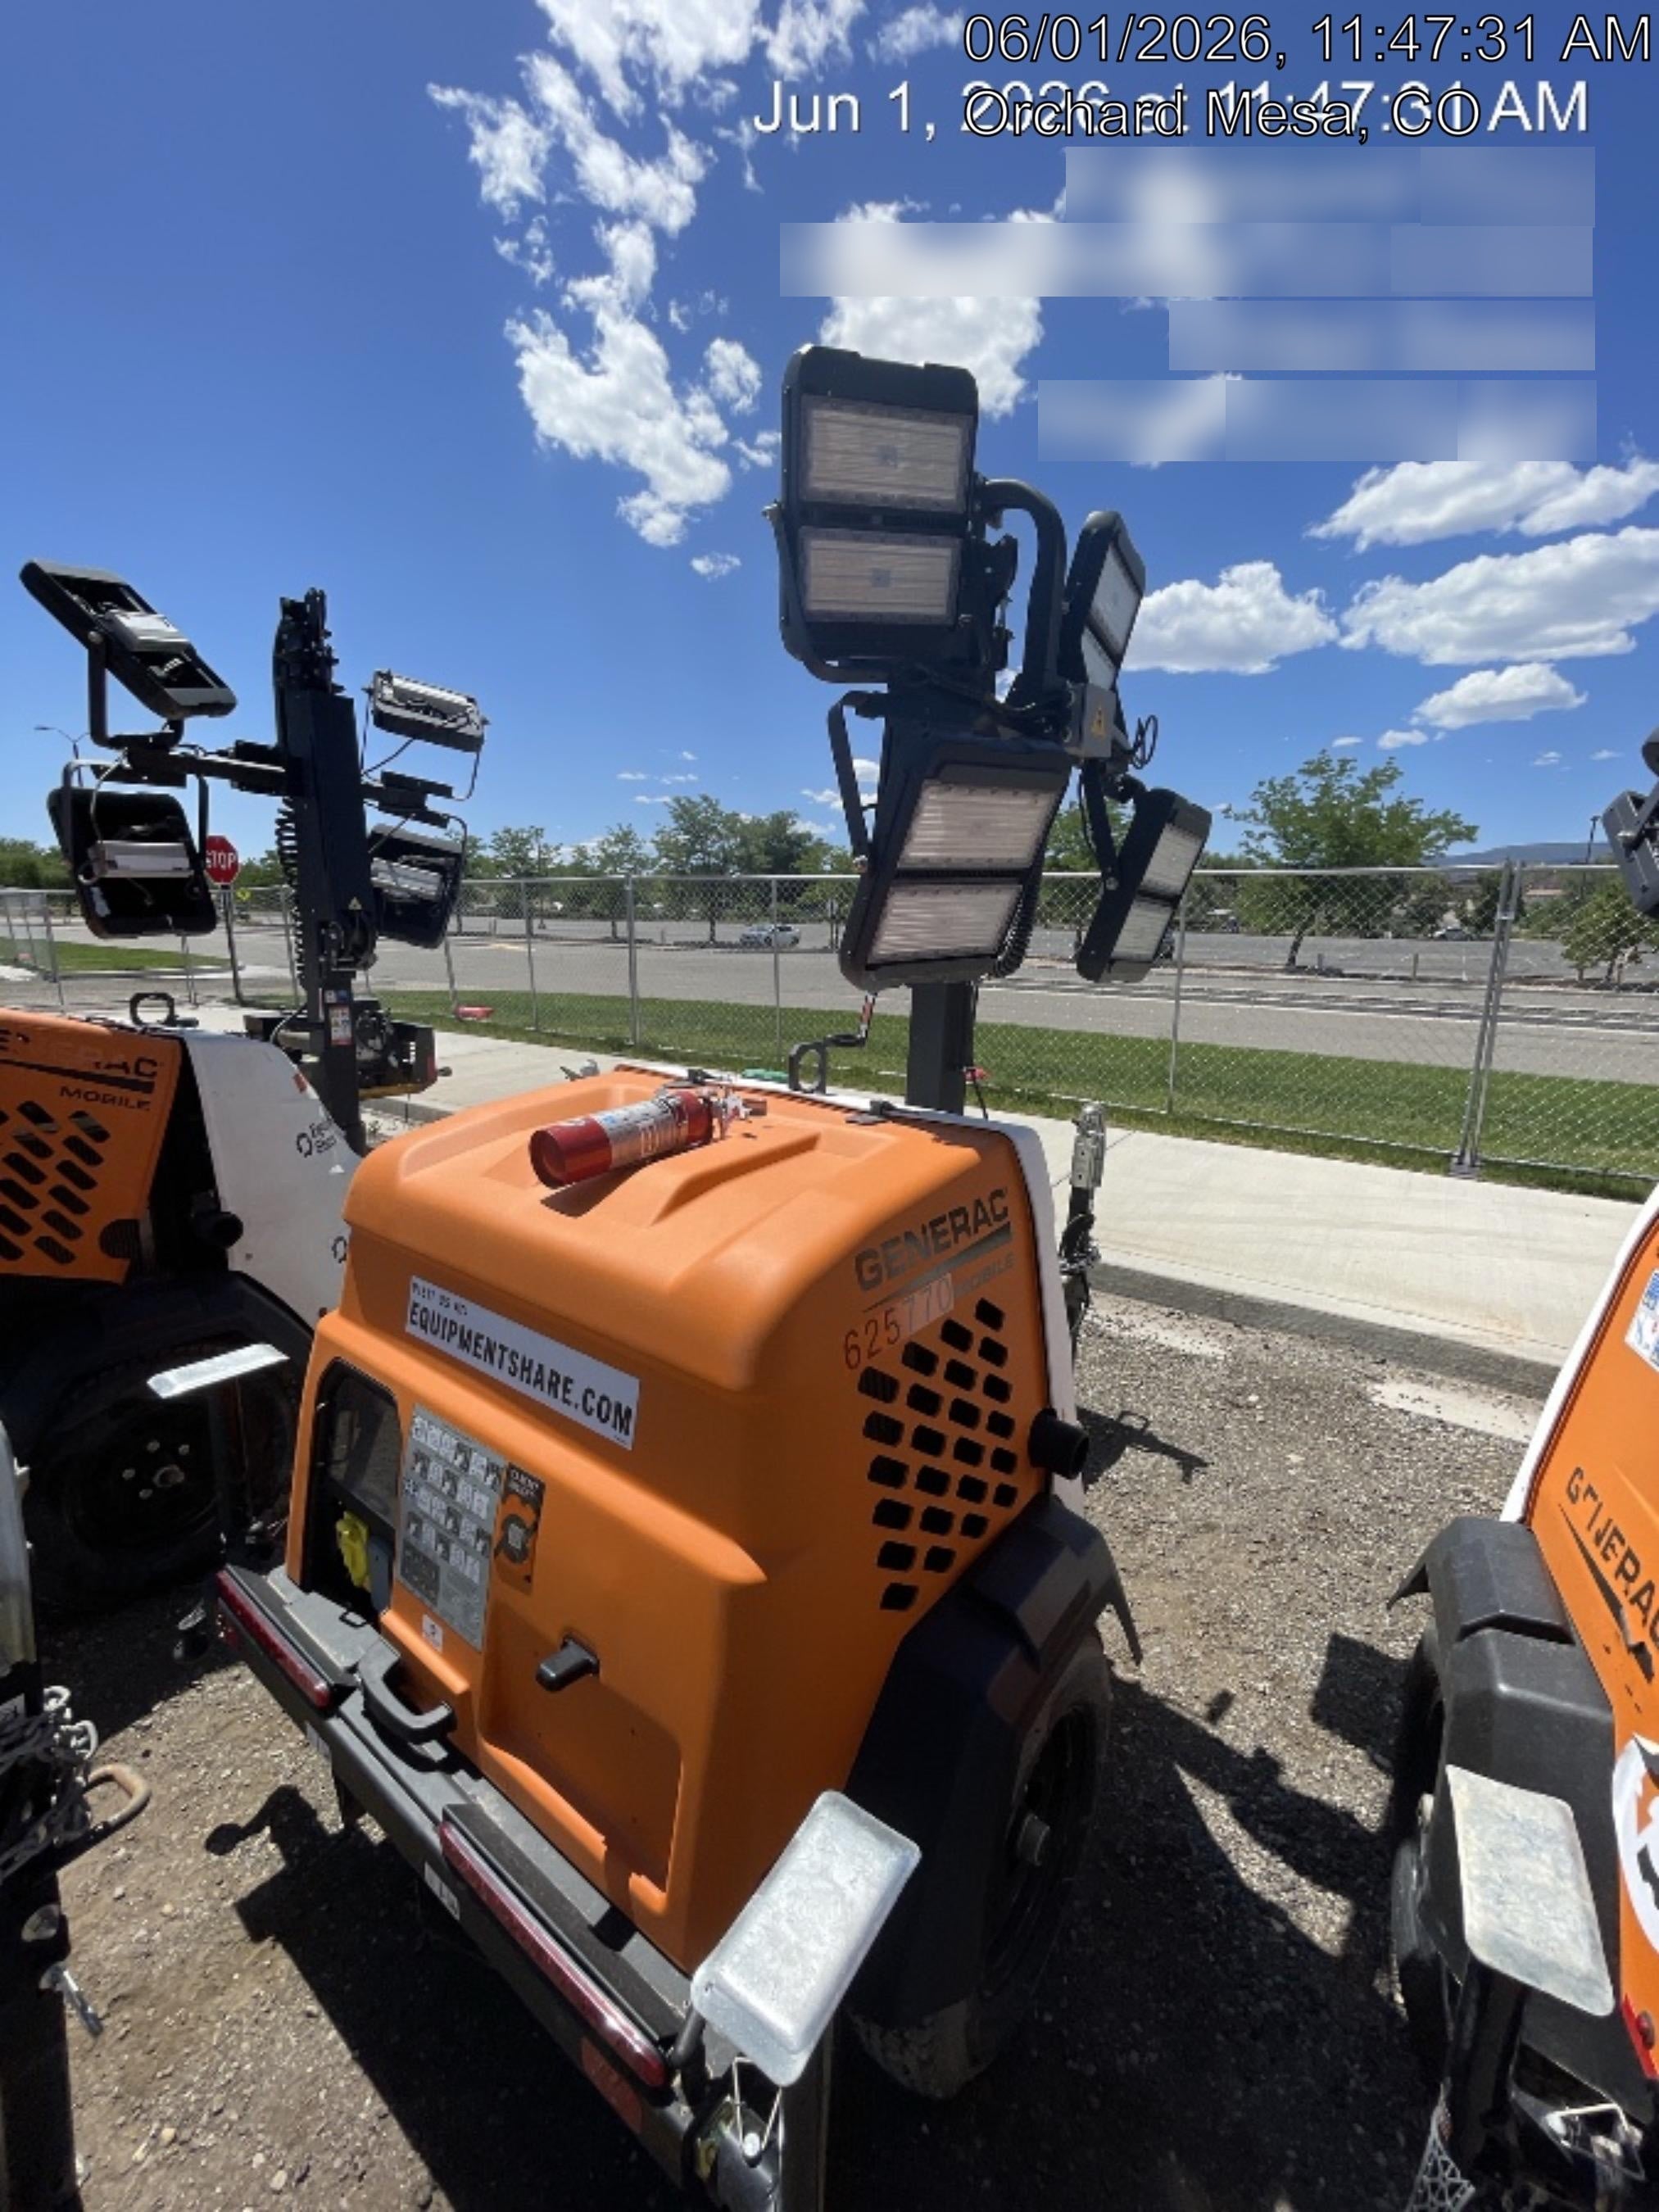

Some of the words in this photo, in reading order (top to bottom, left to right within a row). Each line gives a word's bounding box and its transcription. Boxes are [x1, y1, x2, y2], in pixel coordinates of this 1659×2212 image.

[205, 850, 237, 870] STOP
[59, 1086, 152, 1111] MOBILE
[854, 1188, 1009, 1292] GENERAC
[410, 1302, 633, 1437] EQUIPMENTSHARE.COM
[844, 1276, 953, 1371] 625770
